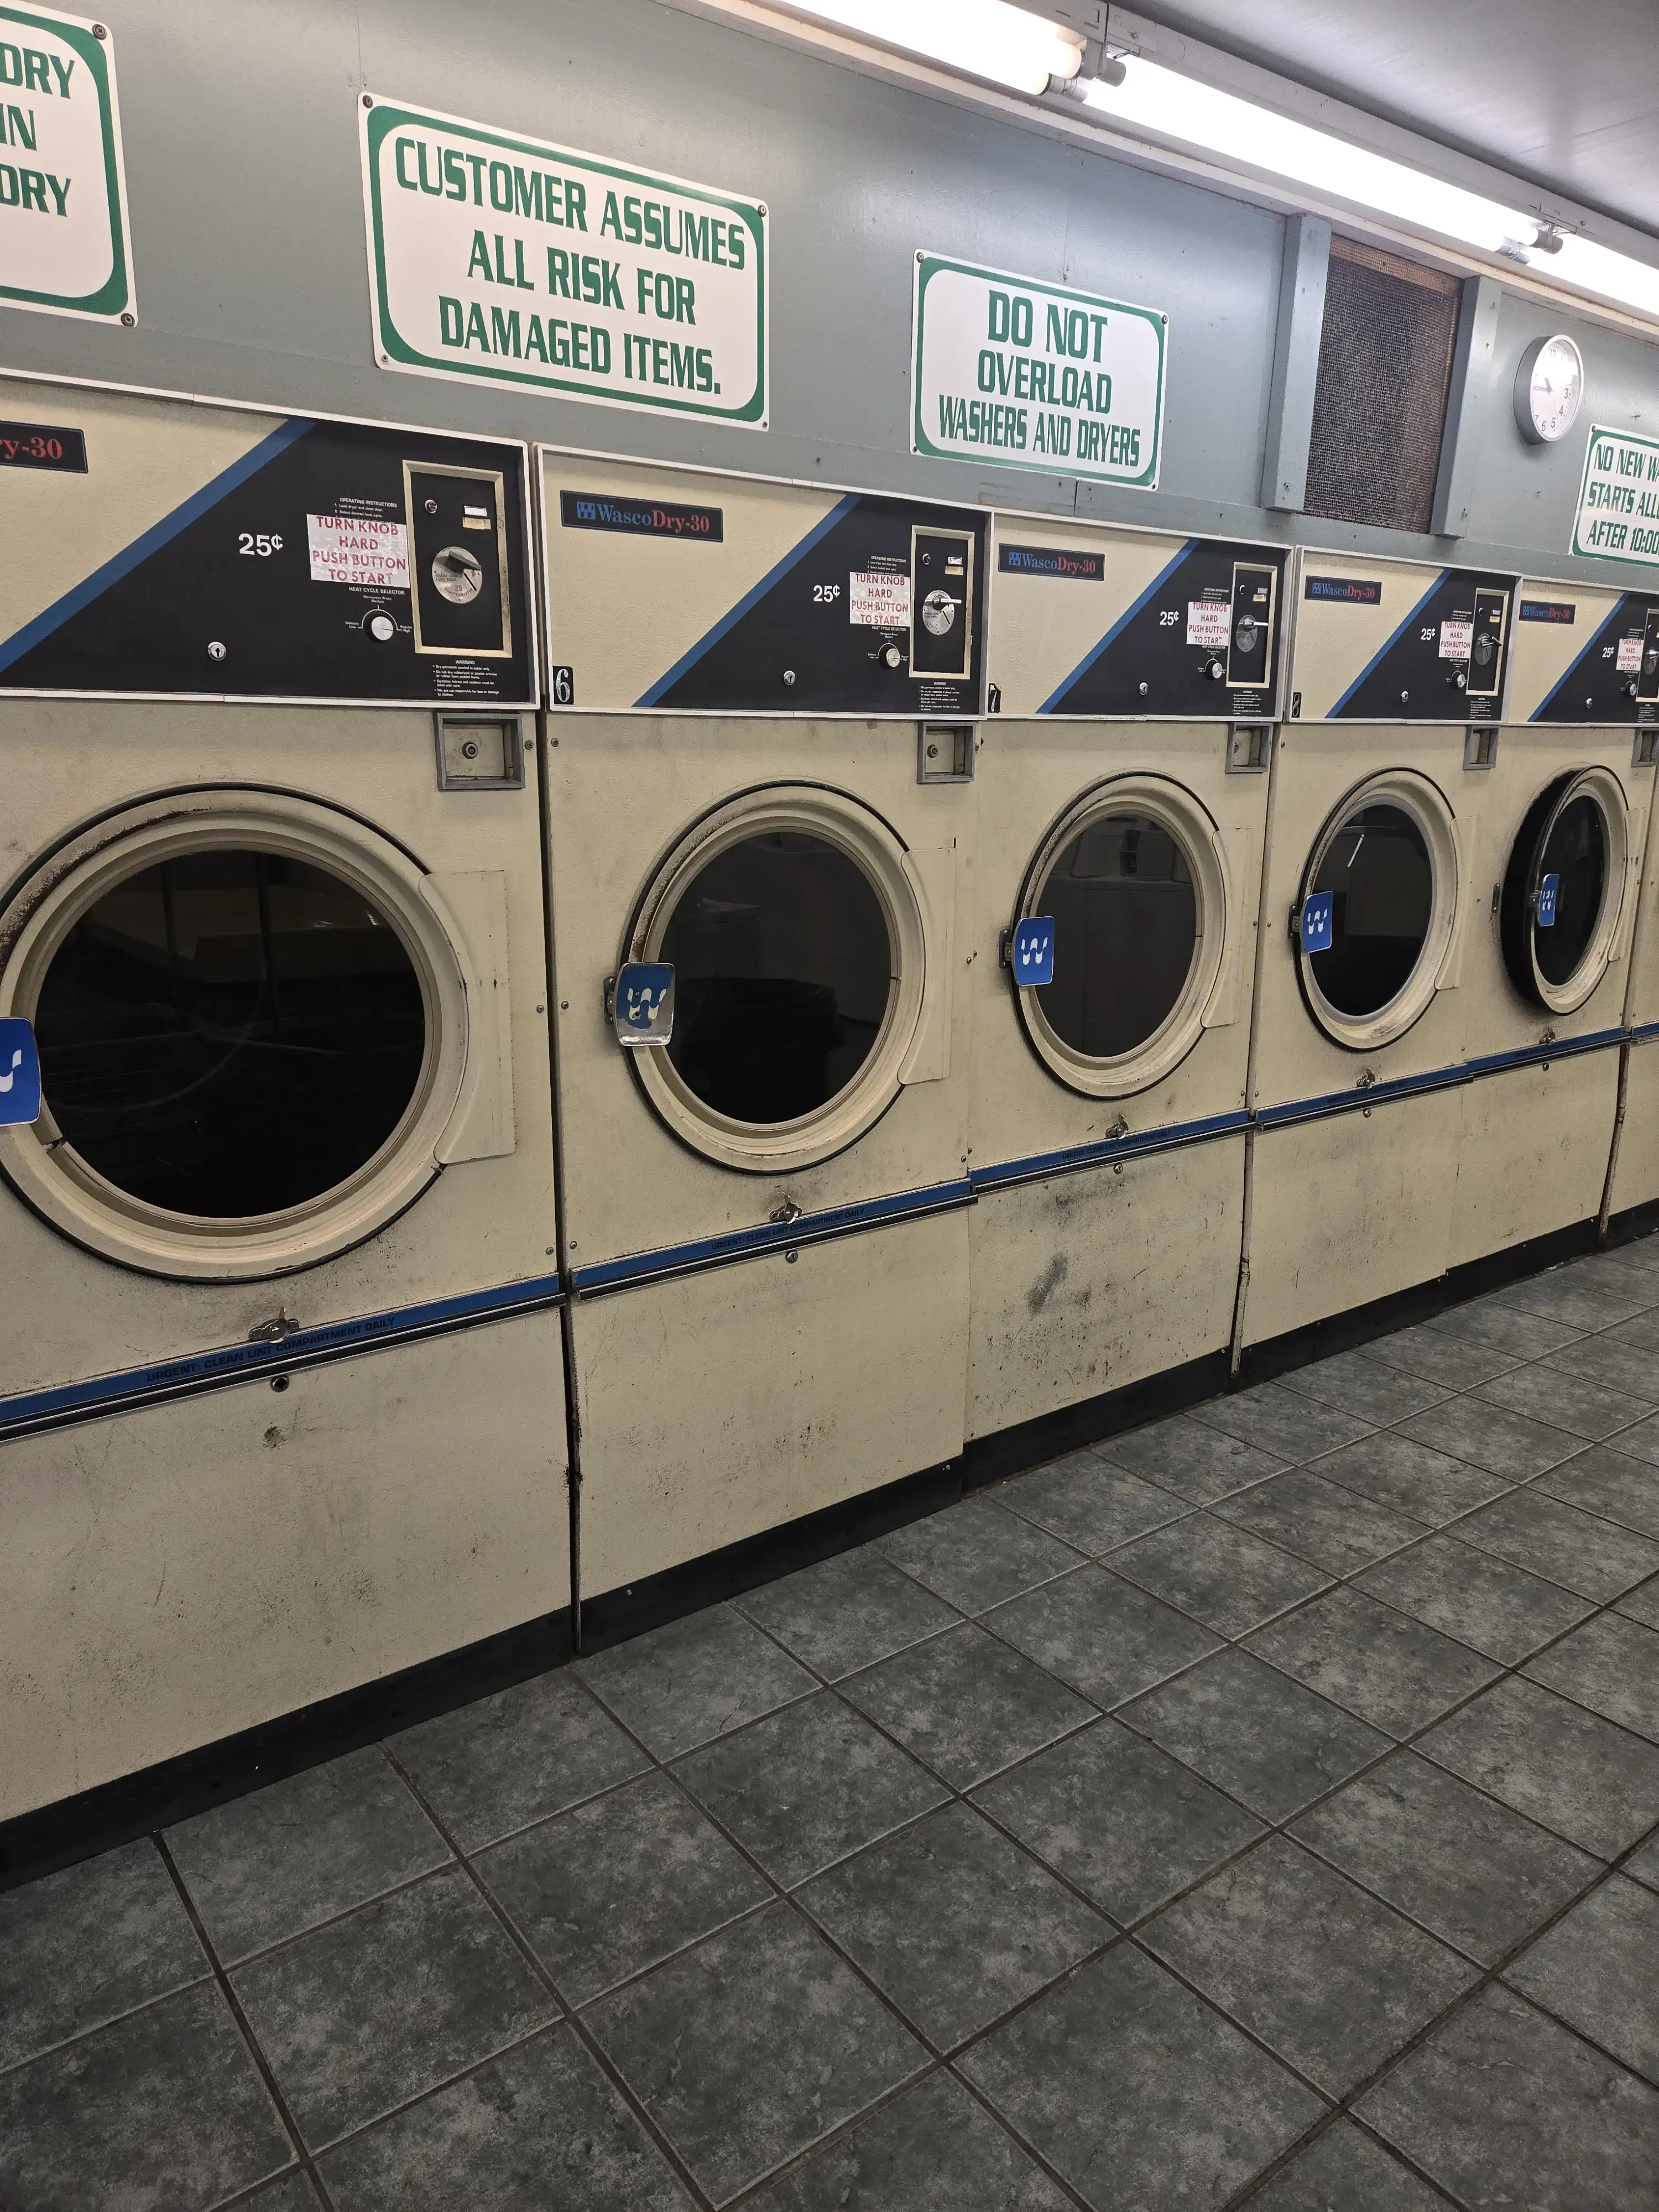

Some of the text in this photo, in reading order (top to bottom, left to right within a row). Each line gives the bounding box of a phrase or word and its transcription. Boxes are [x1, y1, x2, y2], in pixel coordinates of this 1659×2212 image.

[395, 137, 745, 270] CUSTOMER ASSUMES
[467, 229, 696, 325] ALL RISK FOR
[988, 290, 1108, 363] DO NOT
[439, 295, 721, 394] DAMAGED ITEMS.
[978, 349, 1112, 414] OVERLOAD
[1564, 388, 1568, 399] 3
[1559, 405, 1563, 416] 4
[939, 394, 1140, 467] WASHERS AND DRYERS
[1541, 421, 1546, 431] 6
[1551, 417, 1556, 428] 5
[0, 437, 62, 460] y-30
[1594, 444, 1614, 472] NO
[1616, 448, 1646, 478] NEW
[1587, 481, 1636, 514] STARTS
[316, 516, 354, 531] TURN
[358, 521, 398, 535] KNOB
[596, 504, 709, 533] WascoDry-30
[238, 533, 283, 556] 25¢
[340, 535, 378, 550] HARD
[1587, 520, 1627, 550] AFTER
[312, 550, 406, 570] PUSH BUTTON
[1022, 553, 1095, 575] WascoDry-30
[328, 568, 393, 584] TO START
[855, 573, 905, 586] TURN KNOB
[813, 584, 840, 602] 25¢
[868, 588, 893, 598] HARD
[1322, 583, 1375, 601] WascoDry-30
[852, 600, 908, 612] PUSH BUTTON
[1193, 602, 1228, 612] TURN KNOB
[860, 614, 900, 625] TO START
[1160, 611, 1179, 625] 25¢
[1189, 624, 1204, 633] PUSH
[1421, 628, 1436, 640] 25¢
[1602, 646, 1614, 658] 25¢
[556, 669, 570, 702] 6
[1292, 693, 1300, 716] 8
[711, 1208, 865, 1250] URGENT: CLEAN LINT COMPARTMENT DAILY
[147, 1317, 395, 1383] URGENT: CLEAN LINT COMPARTMENT DAILY
